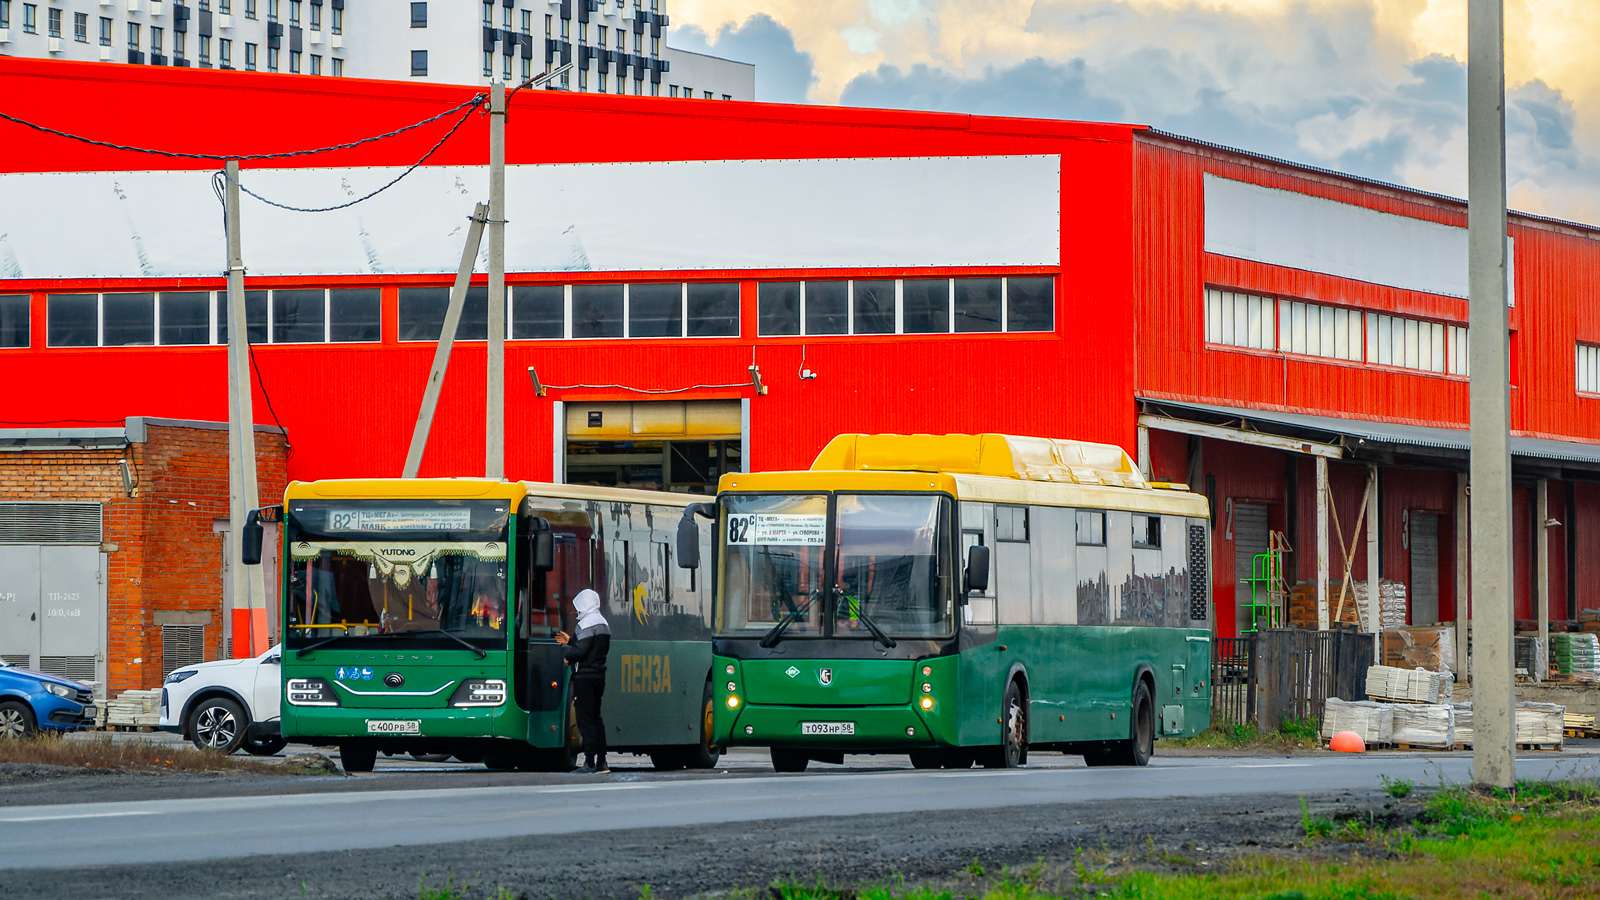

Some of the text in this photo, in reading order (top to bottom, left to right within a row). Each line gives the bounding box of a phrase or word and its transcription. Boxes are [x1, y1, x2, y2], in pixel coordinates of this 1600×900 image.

[1225, 496, 1233, 541] 2
[1402, 508, 1409, 550] 3
[380, 548, 416, 556] YUTONG
[621, 654, 672, 693] ПЕНЗА
